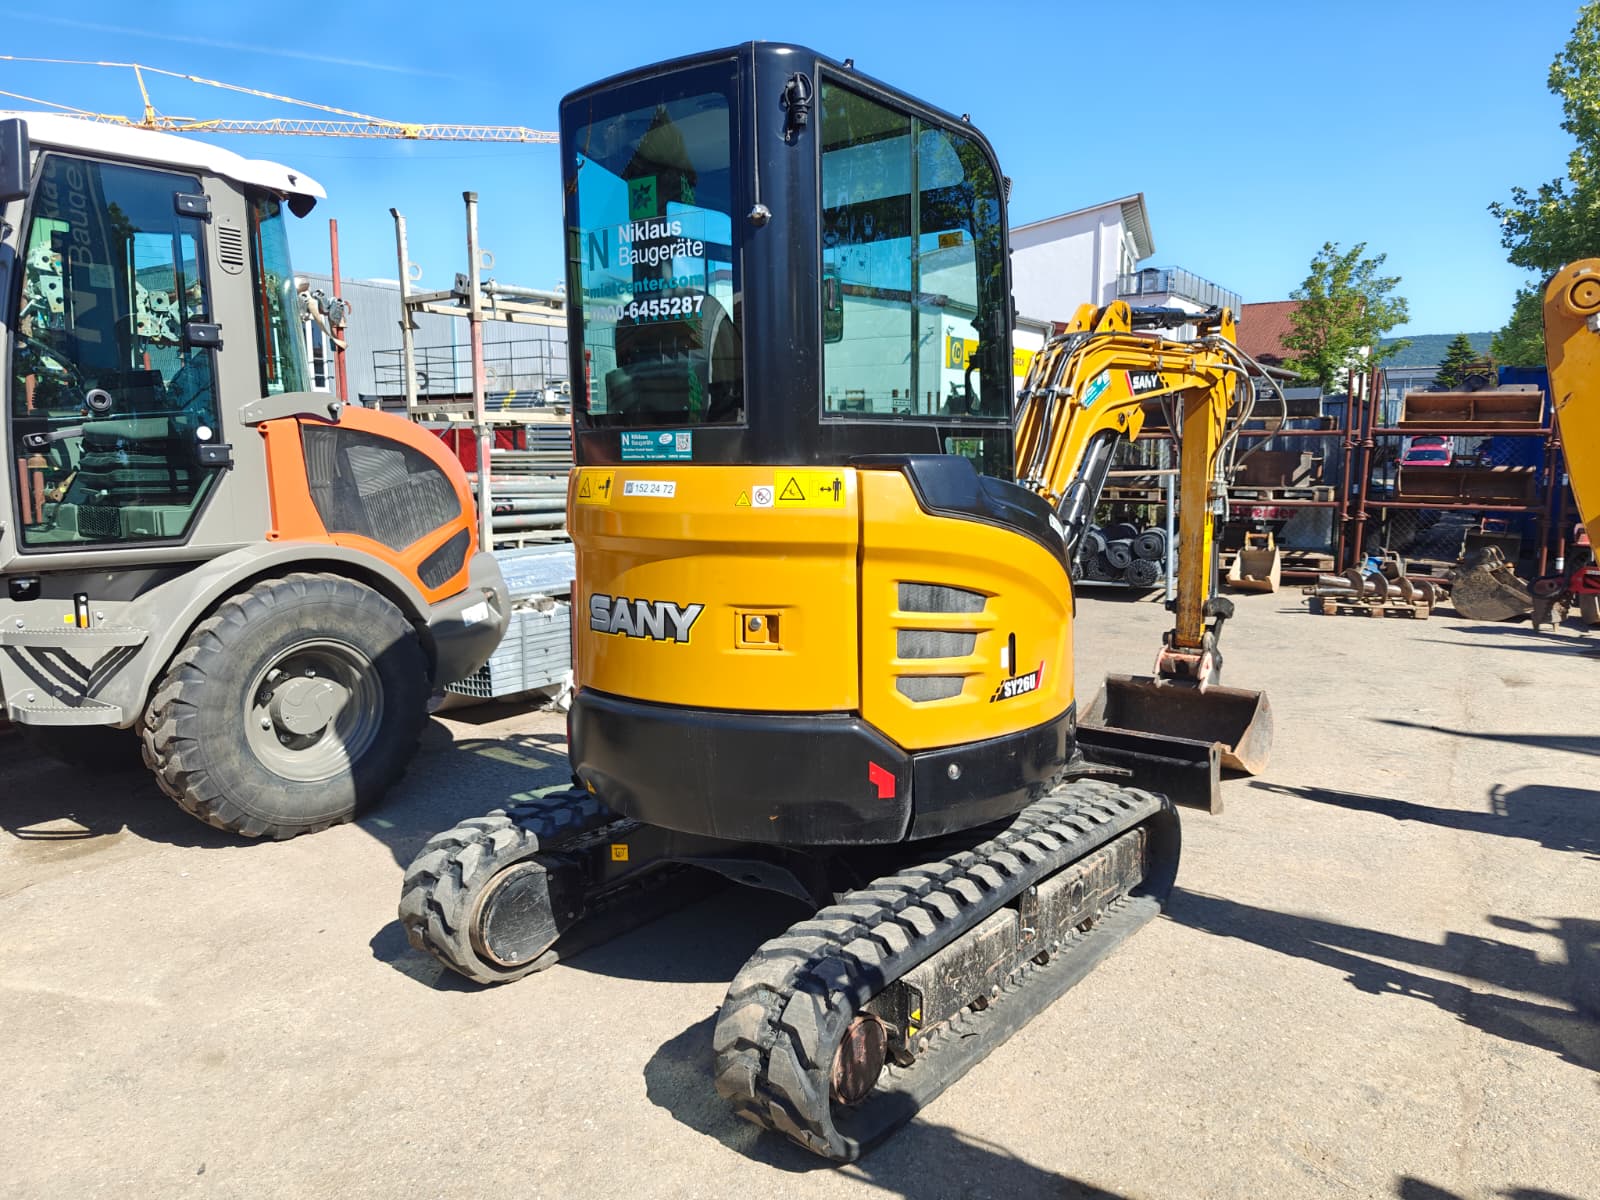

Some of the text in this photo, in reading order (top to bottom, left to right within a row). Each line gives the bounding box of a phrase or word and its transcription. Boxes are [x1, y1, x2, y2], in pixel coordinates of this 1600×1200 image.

[618, 220, 682, 244] Niklaus
[618, 238, 704, 267] Baugeräte
[1132, 374, 1158, 390] SANY
[590, 593, 705, 643] SANY
[1003, 672, 1036, 698] SY26U
